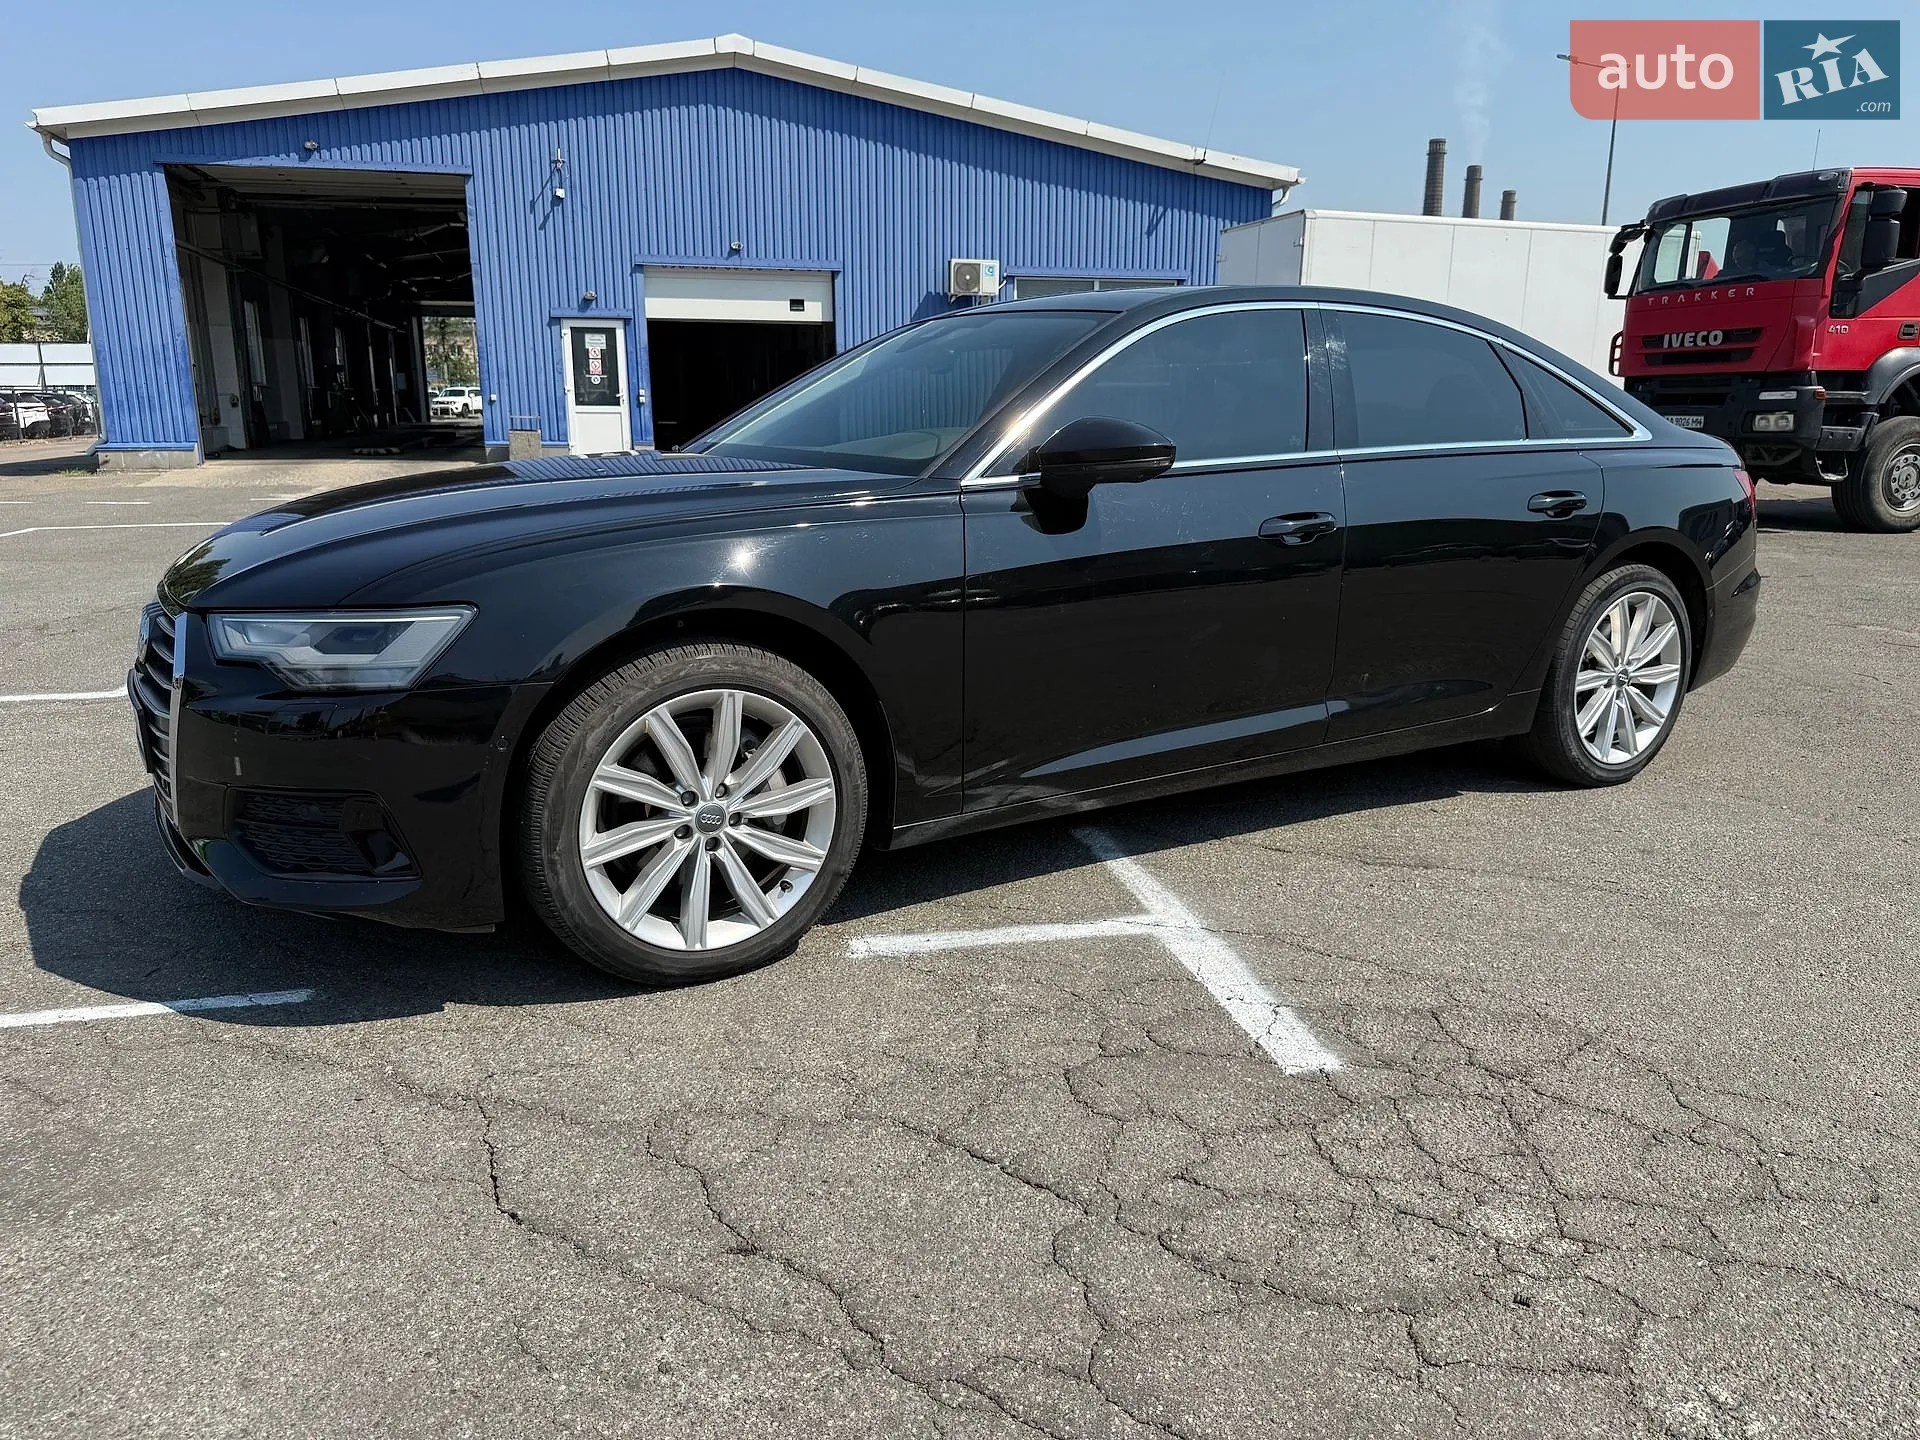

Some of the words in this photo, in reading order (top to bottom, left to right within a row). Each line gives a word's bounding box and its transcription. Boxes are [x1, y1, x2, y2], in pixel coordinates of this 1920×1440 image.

[1648, 287, 1754, 305] TRAKKER
[1828, 325, 1848, 334] 410
[1663, 330, 1723, 348] IVECO
